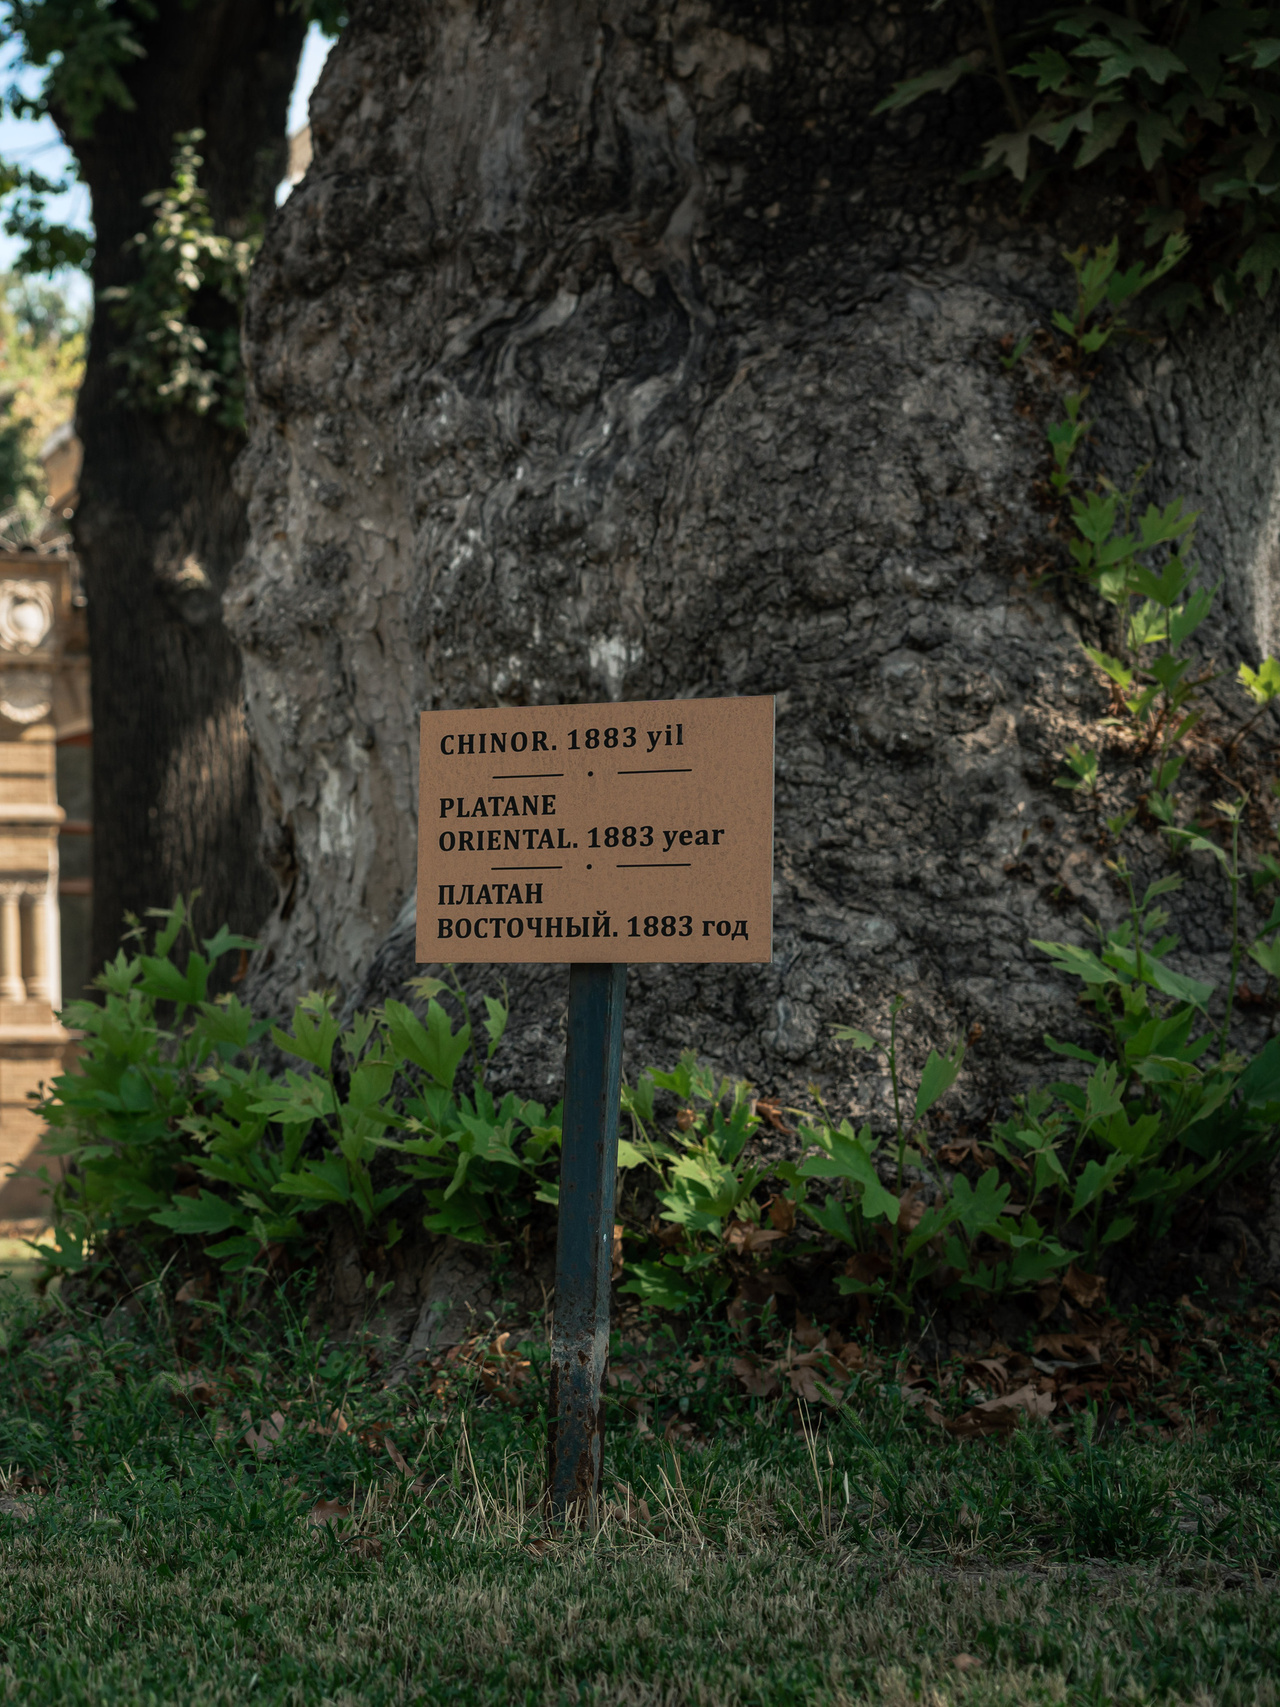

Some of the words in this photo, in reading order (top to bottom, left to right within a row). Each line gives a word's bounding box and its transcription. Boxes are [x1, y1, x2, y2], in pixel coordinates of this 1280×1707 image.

[441, 731, 556, 755] CHINOR.
[568, 727, 636, 750] 1883
[647, 724, 683, 752] yil
[440, 795, 555, 818] PLATANE
[439, 828, 577, 851] ORIENTAL.
[588, 826, 653, 848] 1883
[663, 829, 724, 852] year
[438, 883, 543, 905] ПЛАТАН
[437, 911, 617, 938] ВОСТОЧНЫЙ.
[628, 916, 692, 937] 1883
[702, 921, 748, 940] год
